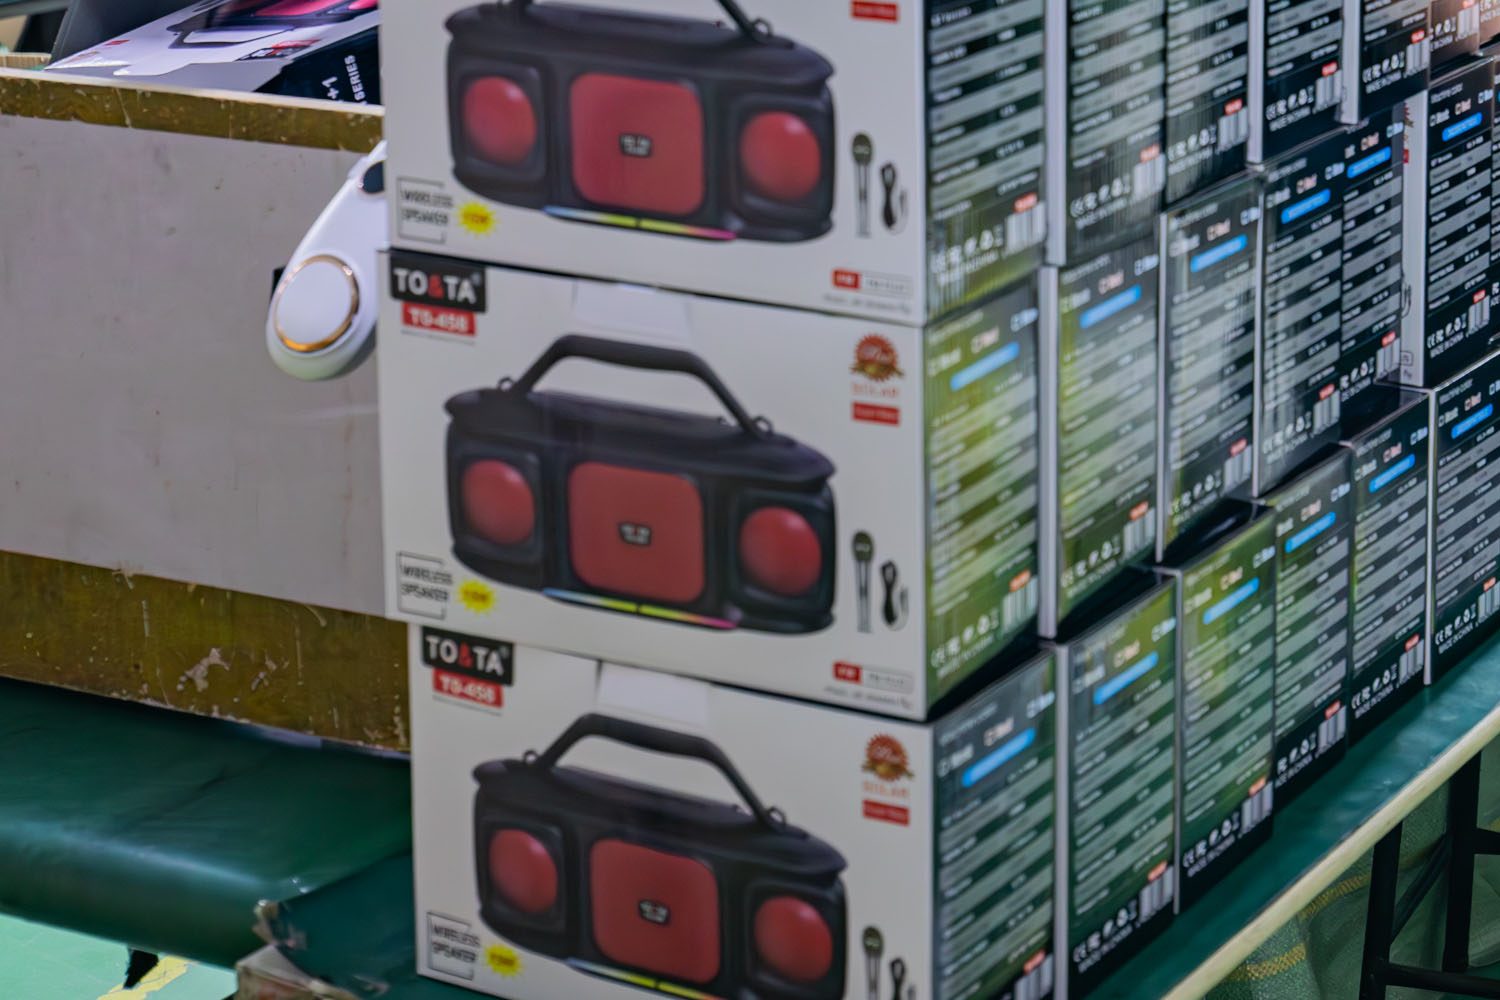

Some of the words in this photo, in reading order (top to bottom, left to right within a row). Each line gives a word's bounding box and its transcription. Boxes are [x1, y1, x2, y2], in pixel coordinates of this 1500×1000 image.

[344, 55, 366, 101] SERIES
[393, 267, 476, 304] TO&TA
[426, 635, 504, 676] TO&TA
